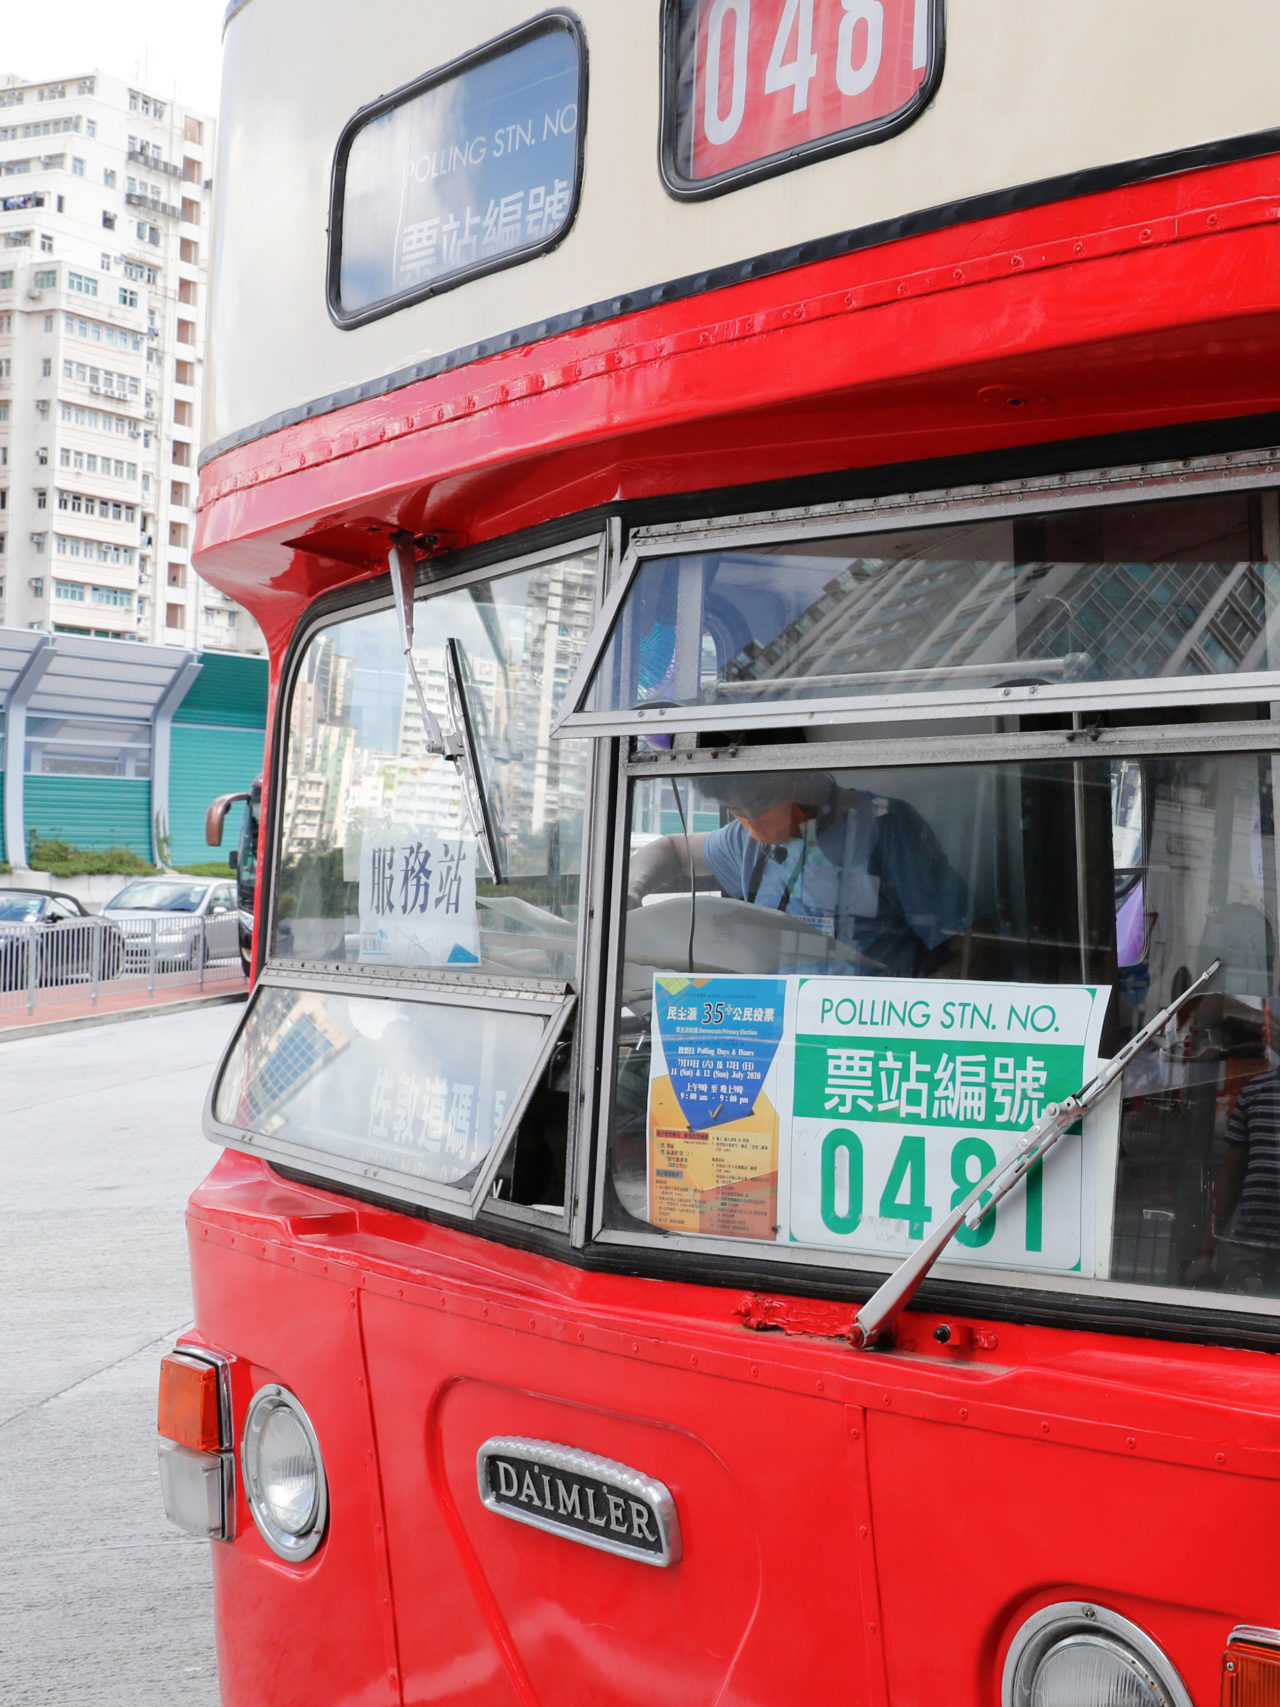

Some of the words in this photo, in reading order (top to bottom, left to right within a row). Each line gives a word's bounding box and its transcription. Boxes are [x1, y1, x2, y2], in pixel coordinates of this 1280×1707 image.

[403, 137, 486, 183] POLLING
[493, 119, 536, 157] STN.
[400, 179, 571, 273] 票站編號
[370, 841, 466, 916] 服務站
[821, 998, 931, 1028] POLLING
[940, 1002, 997, 1030] STN.
[1007, 1004, 1060, 1033] NO.
[713, 1070, 729, 1079] (Sun)
[731, 1071, 744, 1080] July
[824, 1048, 1048, 1125] 票站編號
[821, 1127, 1043, 1252] 0481
[496, 1461, 658, 1542] DAIMLER
